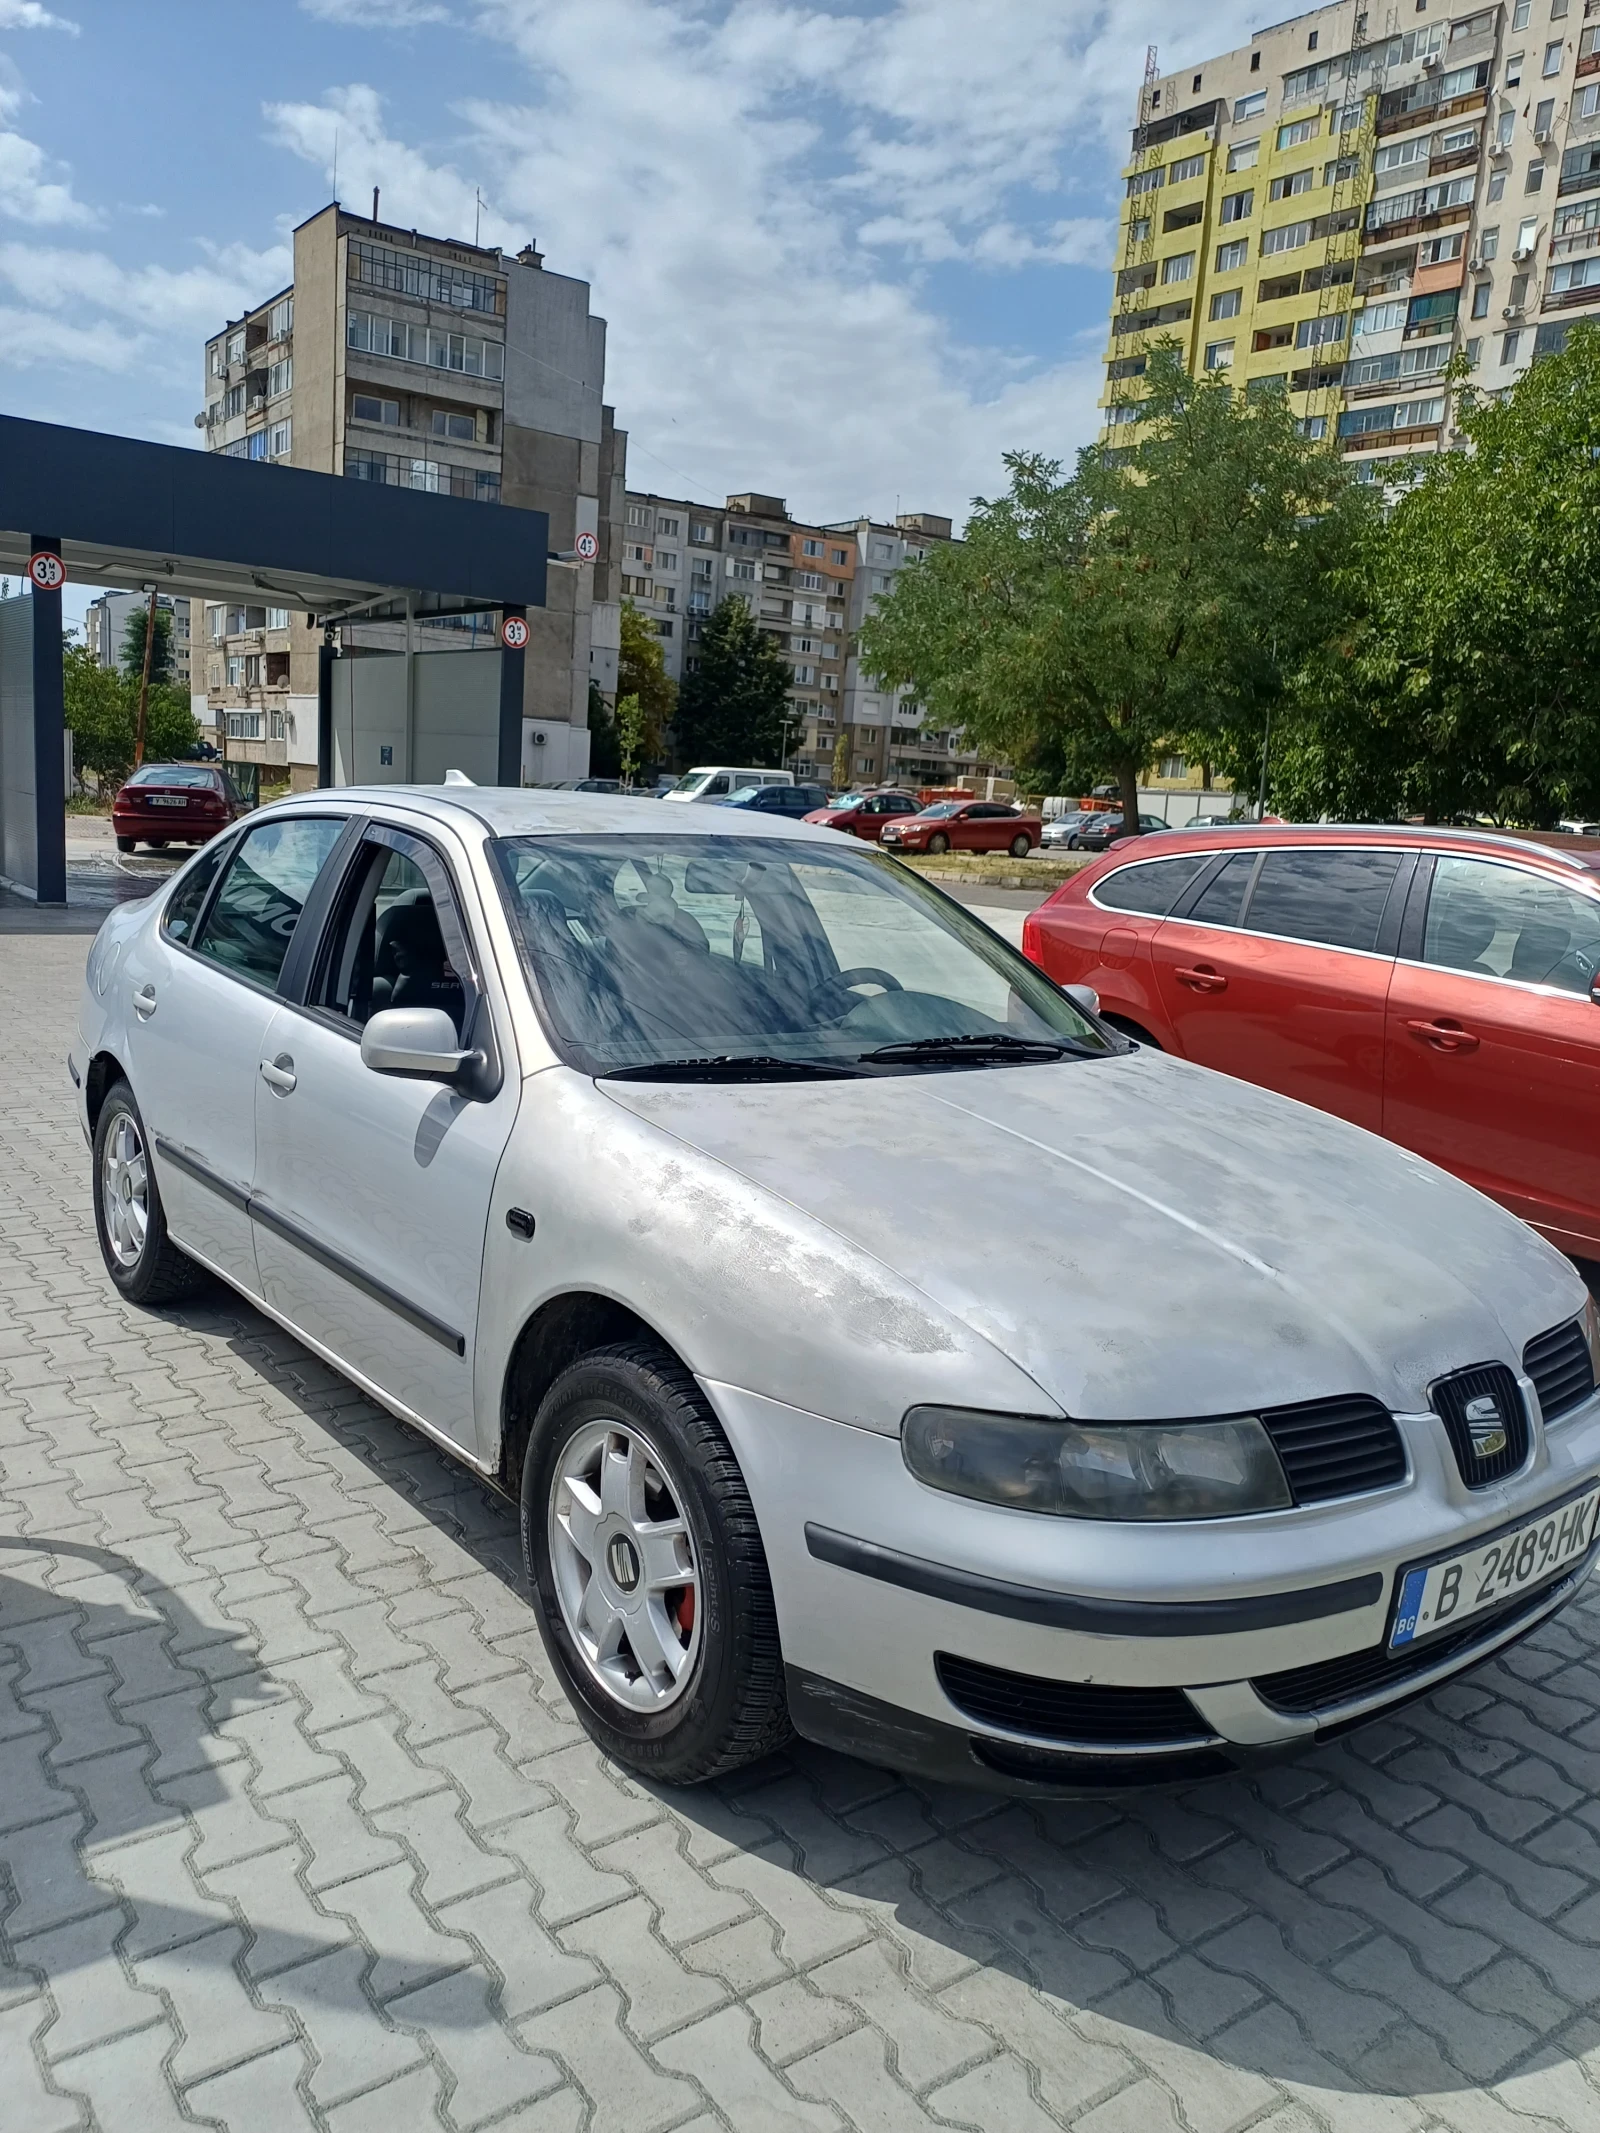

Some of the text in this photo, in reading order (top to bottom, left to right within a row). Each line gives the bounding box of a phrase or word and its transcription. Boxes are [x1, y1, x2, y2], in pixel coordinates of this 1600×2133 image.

[580, 538, 586, 552] 4
[37, 561, 47, 579] 3
[508, 624, 516, 640] 3
[430, 981, 460, 989] SEA
[1434, 1495, 1596, 1622] B 2489 HK
[1397, 1615, 1416, 1636] BG
